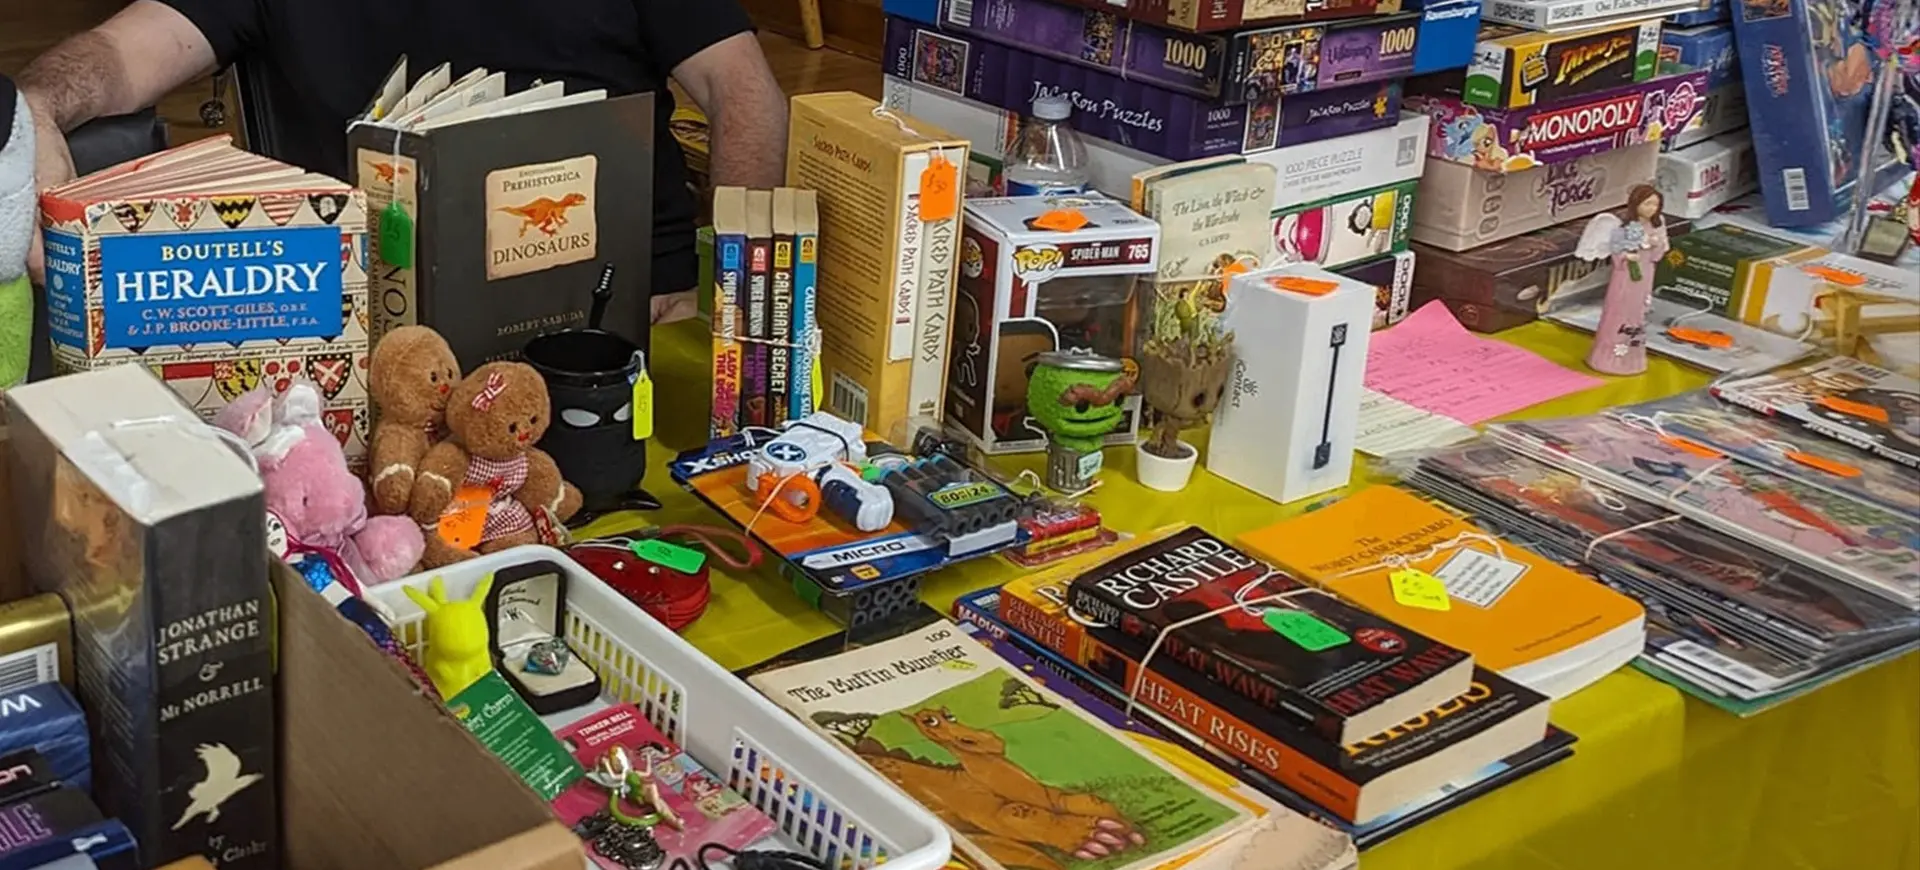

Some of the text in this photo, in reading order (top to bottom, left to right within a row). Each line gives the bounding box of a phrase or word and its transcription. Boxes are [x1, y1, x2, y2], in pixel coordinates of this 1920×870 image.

[1164, 37, 1206, 70] 1000
[1380, 27, 1415, 54] 1000
[1099, 100, 1164, 132] Puzzles
[1207, 109, 1231, 122] 1000
[1529, 100, 1639, 145] MONOPOLY
[503, 172, 581, 193] PREHISTORICA
[161, 239, 285, 262] BOUTELL'S
[493, 232, 591, 266] DINOSAURS
[898, 203, 920, 315] SACRED PATH CARDS
[1013, 247, 1063, 274] POP!
[1128, 243, 1150, 260] 765
[115, 261, 329, 304] HERALDRY
[926, 268, 949, 308] PATH
[921, 312, 945, 364] CARDS
[727, 349, 738, 380] LADY
[771, 347, 787, 394] SECRET
[832, 541, 907, 563] MICRO
[1096, 536, 1224, 597] RICHARD
[1123, 550, 1257, 610] CASTLE
[157, 599, 260, 647] JONATHAN
[1005, 608, 1067, 651] CASTLE
[1008, 597, 1067, 635] RICHARD
[1074, 601, 1119, 629] CASTLE
[158, 620, 260, 664] STRANGE
[199, 661, 225, 682] &
[787, 643, 968, 704] The Muffin Muncher
[182, 677, 264, 713] NORRELL
[578, 717, 611, 738] TINKER
[610, 710, 633, 726] BELL
[1140, 674, 1206, 727] HEAT
[1208, 716, 1281, 773] RISES
